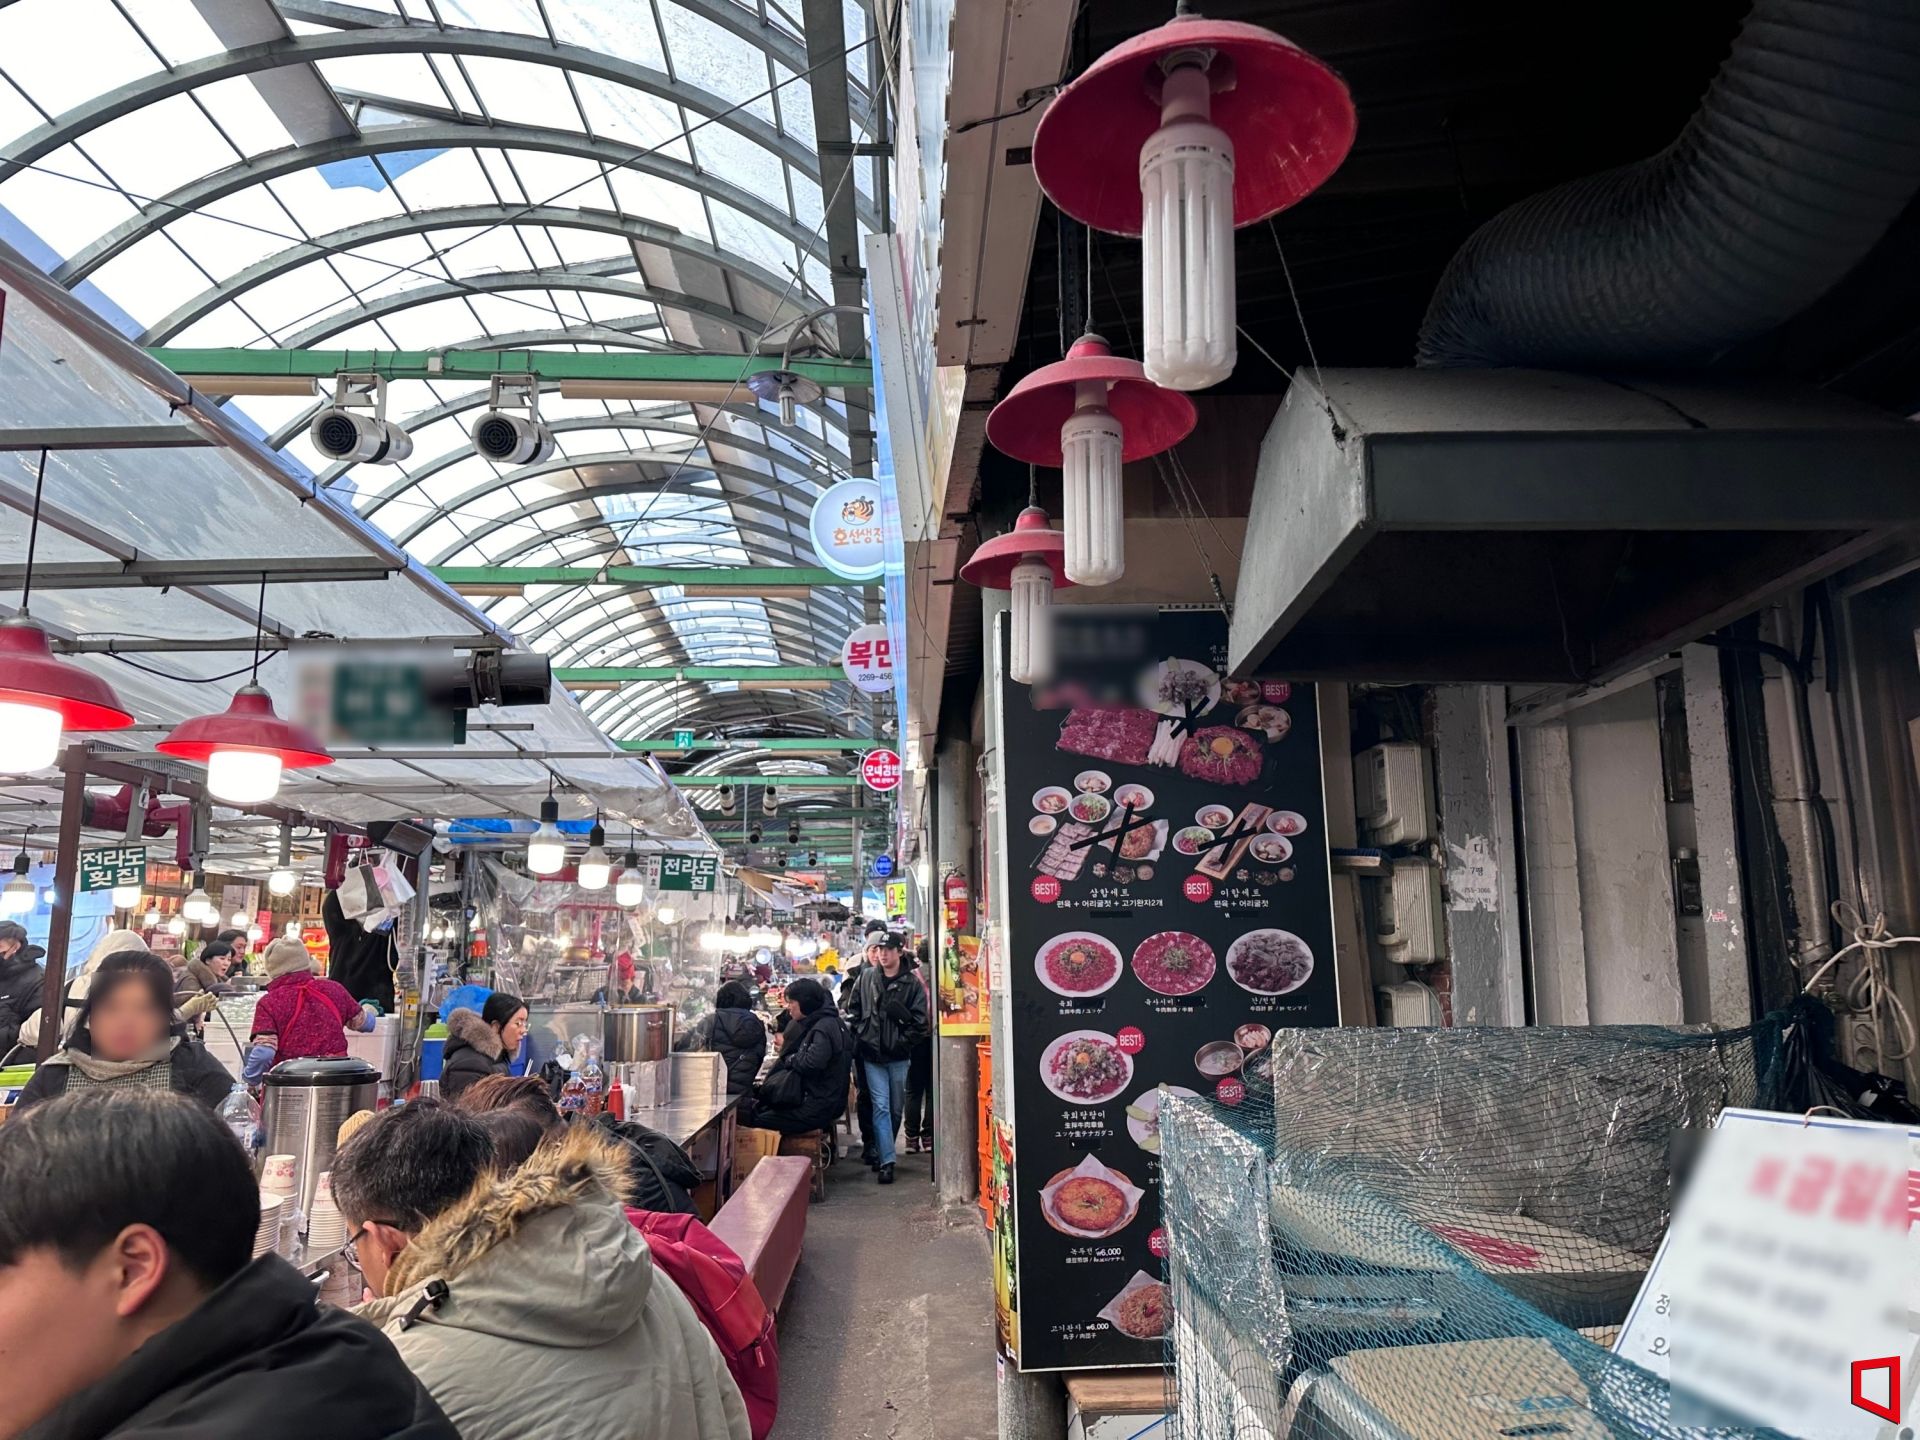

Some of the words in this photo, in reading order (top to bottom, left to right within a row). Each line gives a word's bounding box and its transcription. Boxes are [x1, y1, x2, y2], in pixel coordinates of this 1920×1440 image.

[858, 672, 893, 681] 2269-456
[1265, 684, 1288, 696] BEST!
[83, 848, 145, 871] 전라도
[664, 858, 715, 876] 전라도
[89, 867, 140, 887] 횟집
[690, 876, 708, 890] 집
[1034, 883, 1058, 896] BEST!
[1089, 888, 1130, 898] 삼합세트
[1186, 882, 1210, 895] BEST!
[1220, 888, 1261, 898] 이합세트
[1056, 900, 1071, 908] 편육
[1121, 899, 1163, 907] 고기완자2개
[1214, 900, 1229, 908] 편육
[1120, 1034, 1142, 1047] BEST!
[1656, 1294, 1670, 1317] 정
